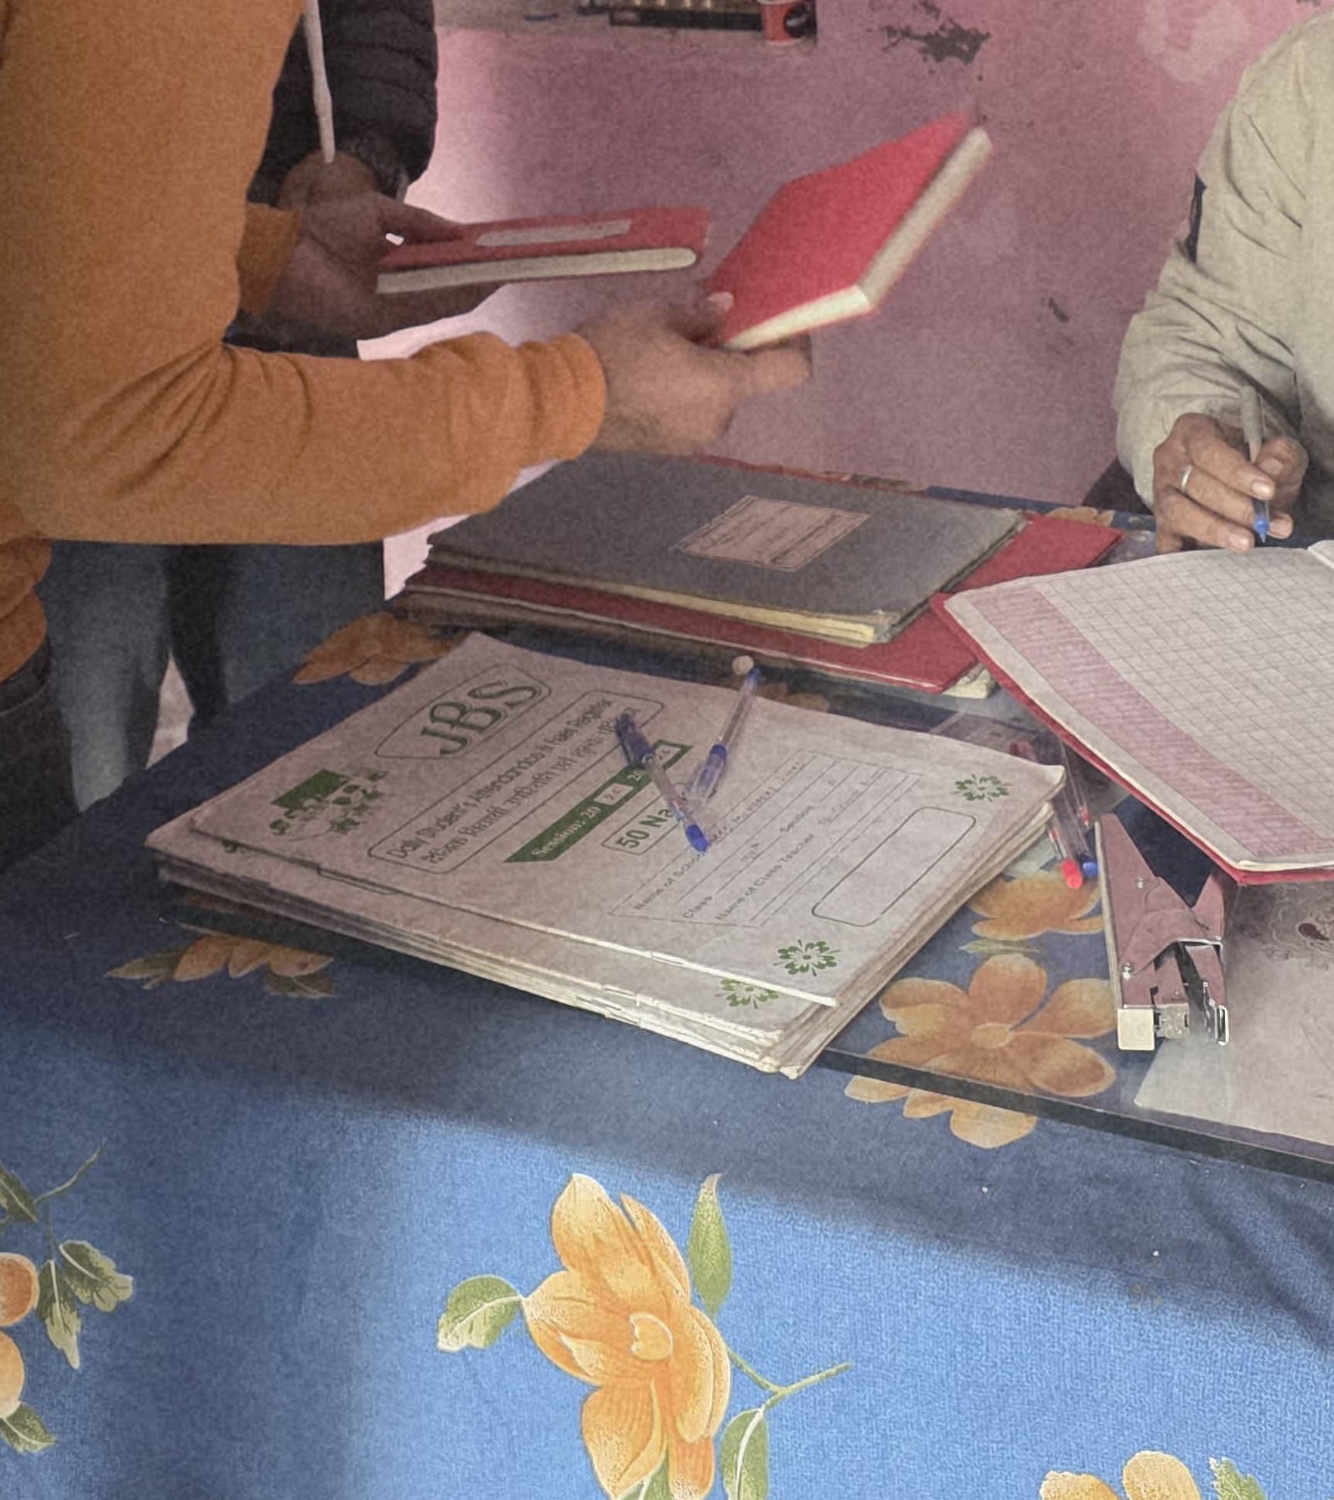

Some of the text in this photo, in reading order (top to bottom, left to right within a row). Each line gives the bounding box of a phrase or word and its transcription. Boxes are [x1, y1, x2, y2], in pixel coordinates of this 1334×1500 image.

[420, 679, 544, 757] JBS
[529, 804, 603, 856] Session: 20
[616, 828, 650, 849] 50
